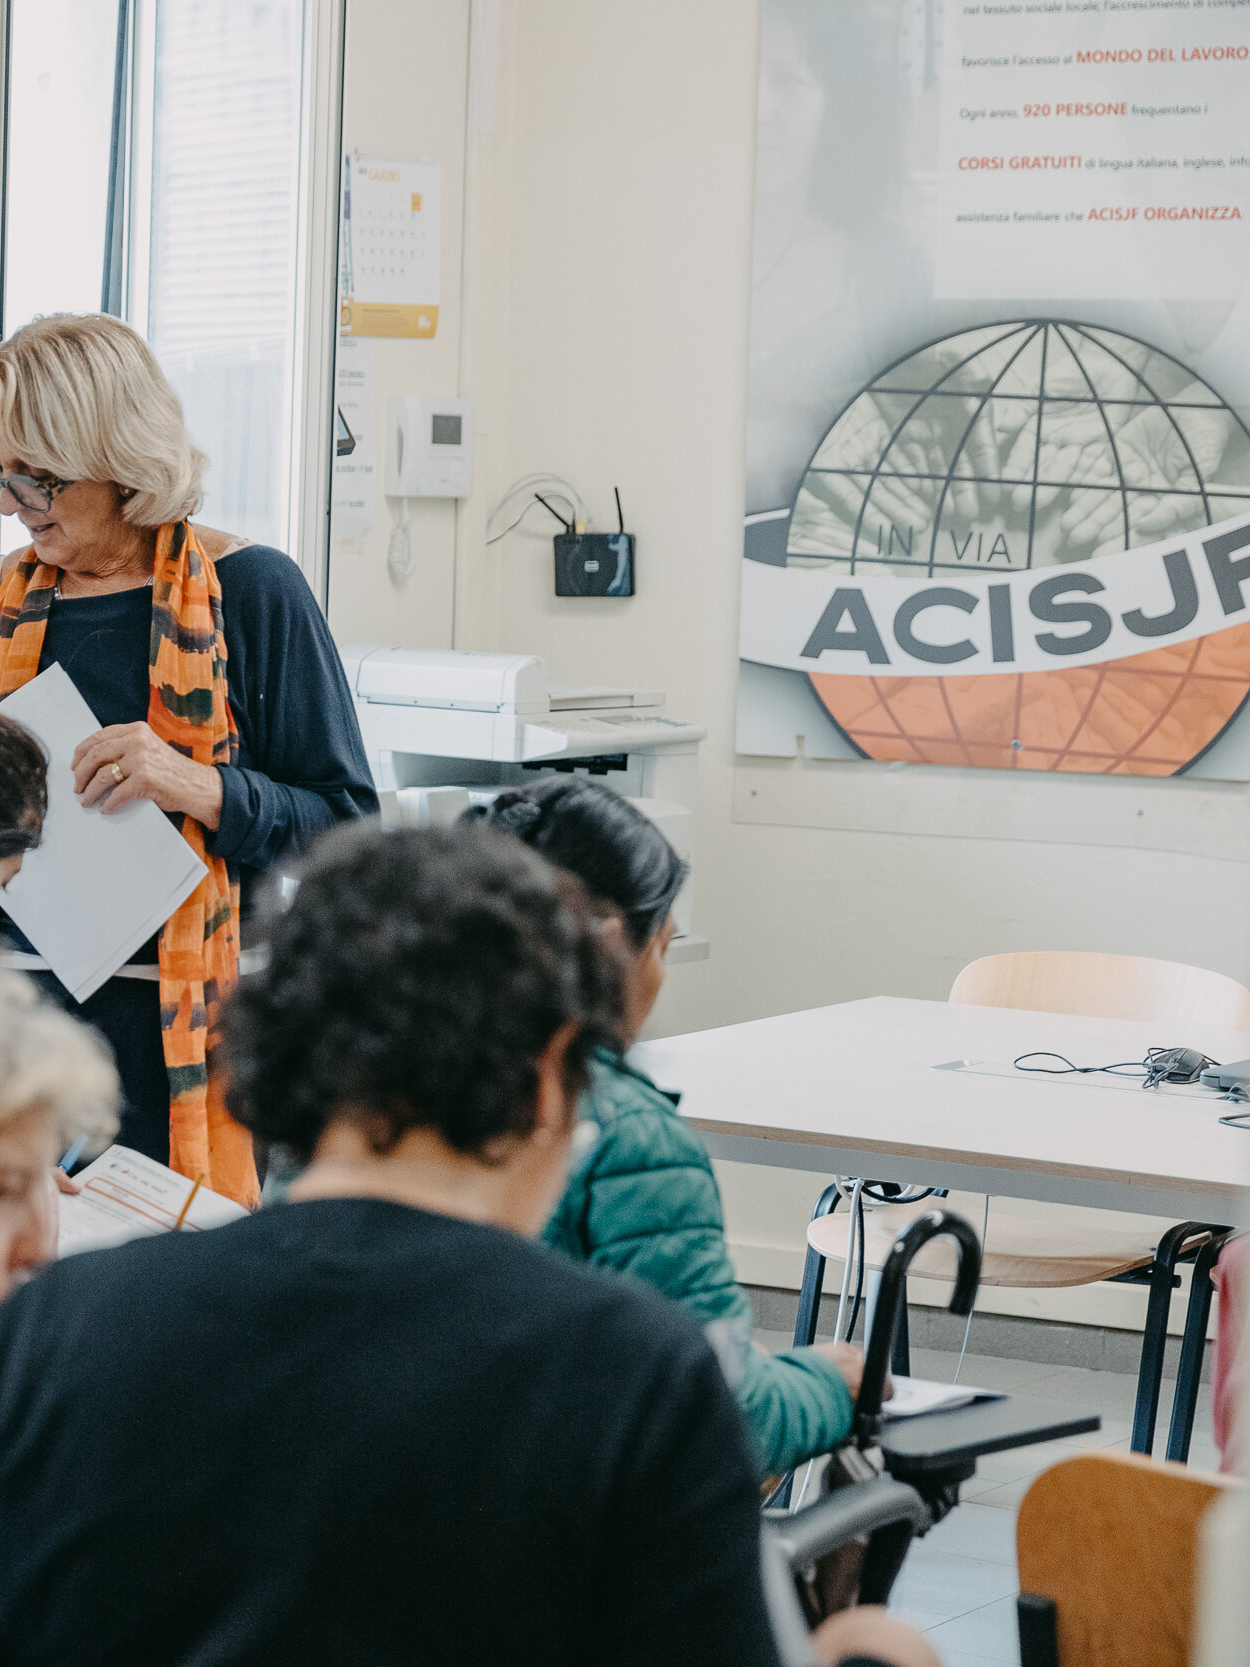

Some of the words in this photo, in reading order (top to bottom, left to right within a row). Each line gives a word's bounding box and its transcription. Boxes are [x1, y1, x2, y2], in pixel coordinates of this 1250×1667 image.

[983, 3, 1023, 14] tessuto
[1025, 2, 1063, 13] sociale
[961, 55, 1010, 67] favorisce
[1012, 53, 1060, 65] l'accesso
[1063, 53, 1073, 64] al
[1076, 49, 1142, 63] MONDO
[1147, 48, 1176, 62] DEL
[1181, 46, 1249, 61] LAVORO
[959, 107, 986, 121] Ogni
[1023, 103, 1051, 117] 920
[1055, 102, 1128, 116] PERSONE
[1131, 104, 1202, 118] frequentano
[958, 156, 1004, 170] CORSI
[1009, 156, 1082, 169] GRATUITI
[1085, 158, 1096, 169] di
[1099, 158, 1133, 171] lingua
[955, 212, 1010, 223] assistenza
[1013, 211, 1060, 222] familiare
[1064, 210, 1084, 221] che
[1087, 207, 1139, 221] ACISJF
[1143, 206, 1242, 220] ORGANIZZA
[877, 523, 914, 557] IN
[950, 532, 1012, 564] VIA
[800, 524, 1250, 665] ACISJF
